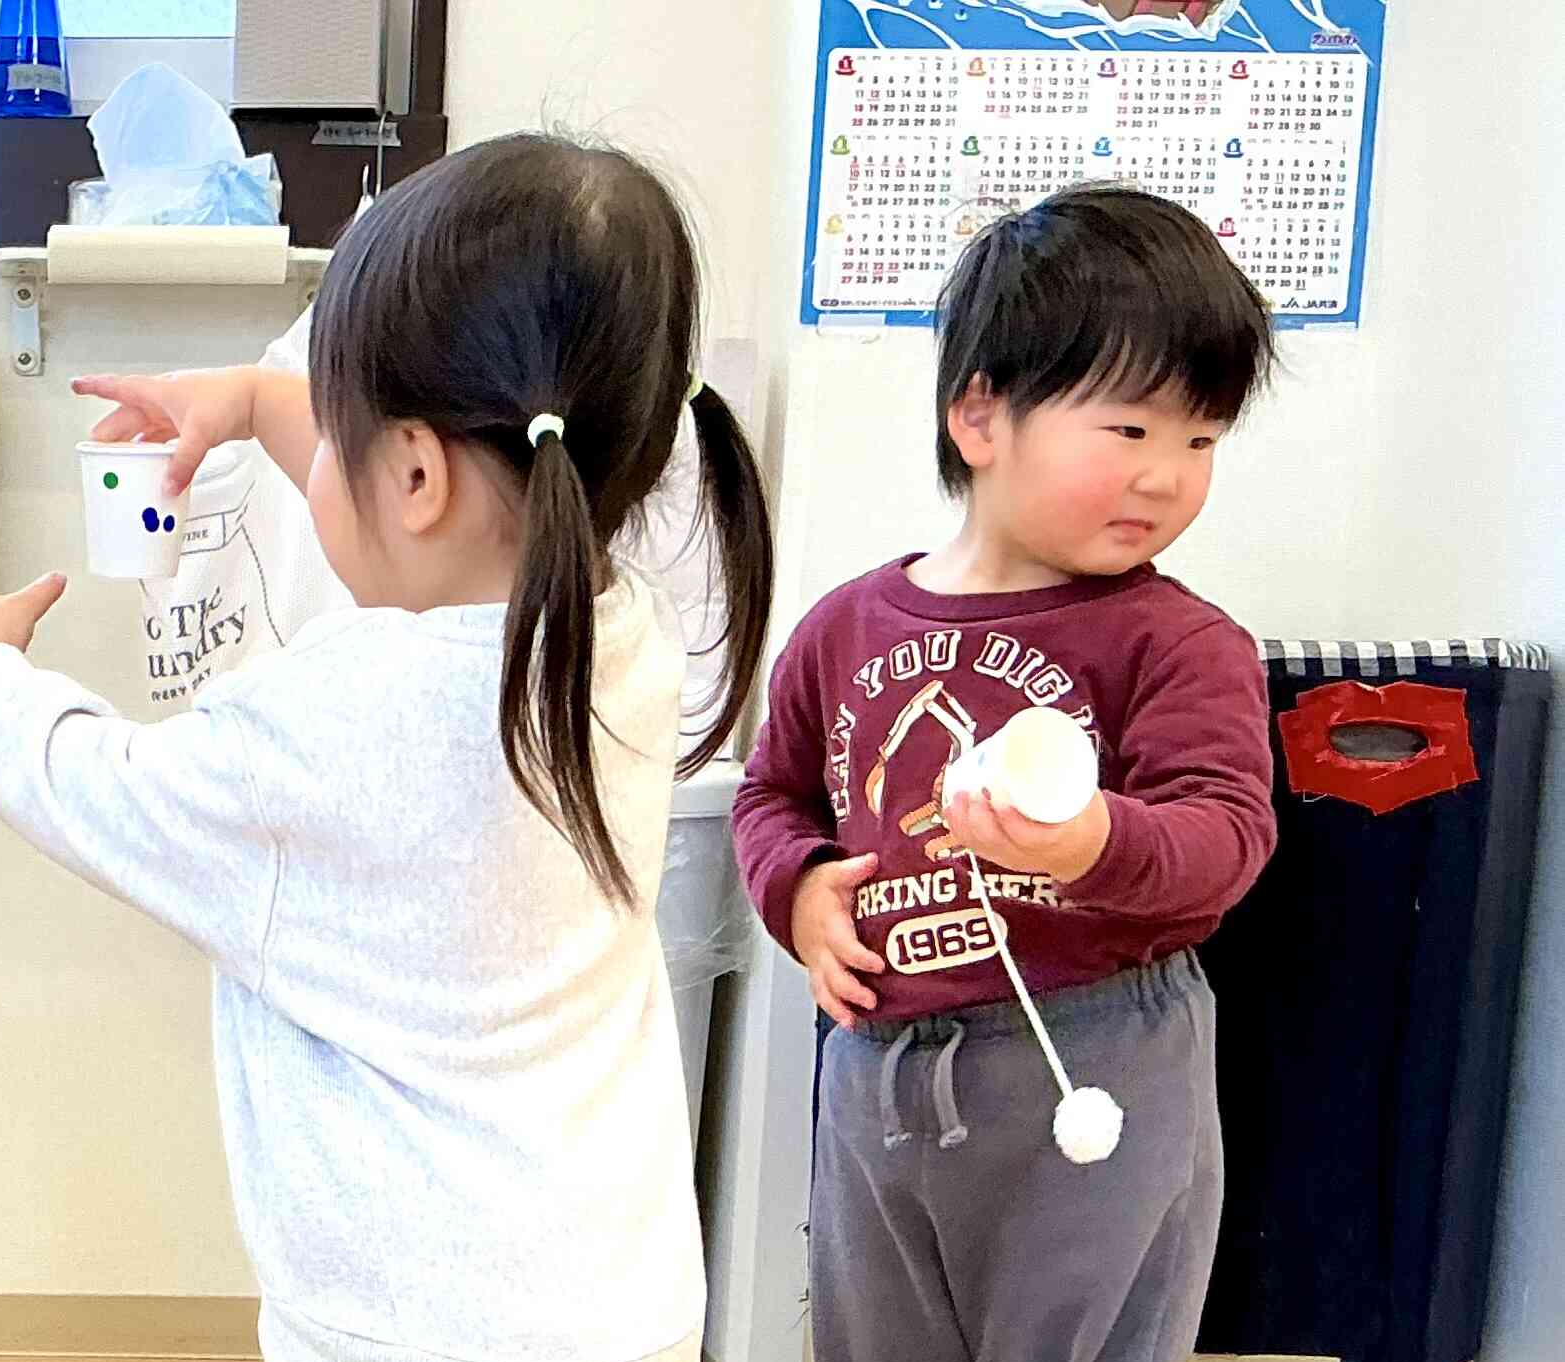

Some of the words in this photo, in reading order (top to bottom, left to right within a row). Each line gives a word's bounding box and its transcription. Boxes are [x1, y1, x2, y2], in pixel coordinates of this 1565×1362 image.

[147, 603, 248, 679] undry
[852, 629, 962, 700] YOU
[972, 631, 1075, 707] DIG
[855, 868, 957, 920] RKING
[895, 917, 996, 965] 1969
